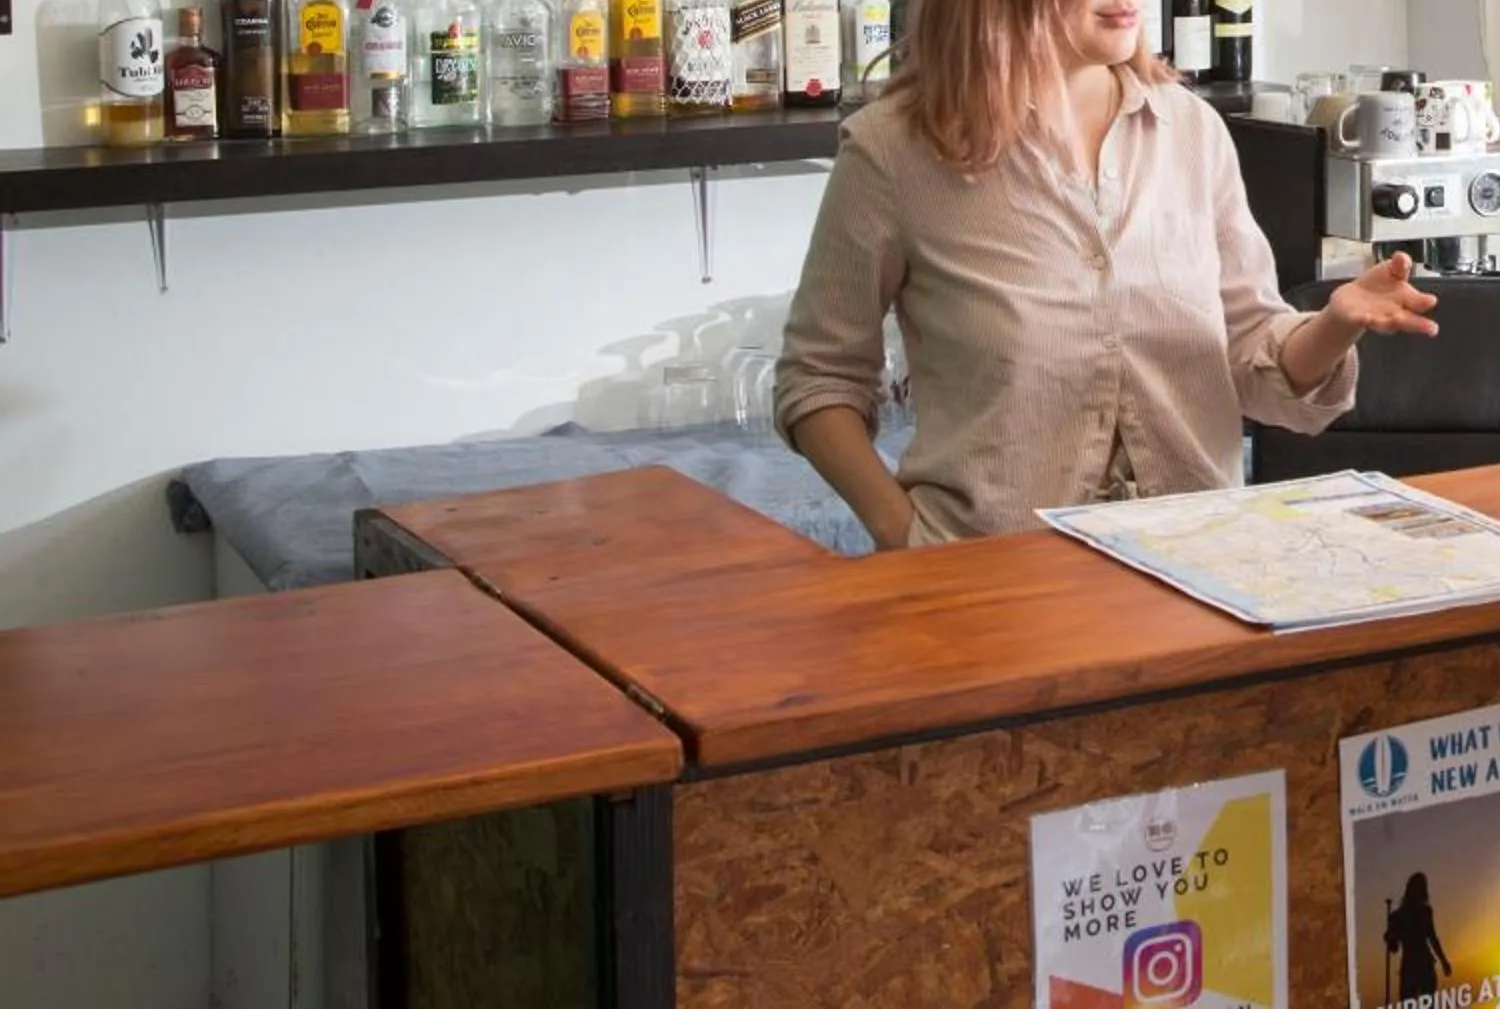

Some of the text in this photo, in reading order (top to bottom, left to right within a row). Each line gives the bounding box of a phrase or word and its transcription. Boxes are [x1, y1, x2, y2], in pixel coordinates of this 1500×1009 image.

[1430, 725, 1492, 760] WHAT
[1431, 766, 1477, 795] NEW
[1063, 848, 1229, 898] WE LOVE TO
[1063, 875, 1209, 921] SHOW YOU
[1064, 911, 1137, 942] MORE
[1376, 982, 1472, 1009] PPING
